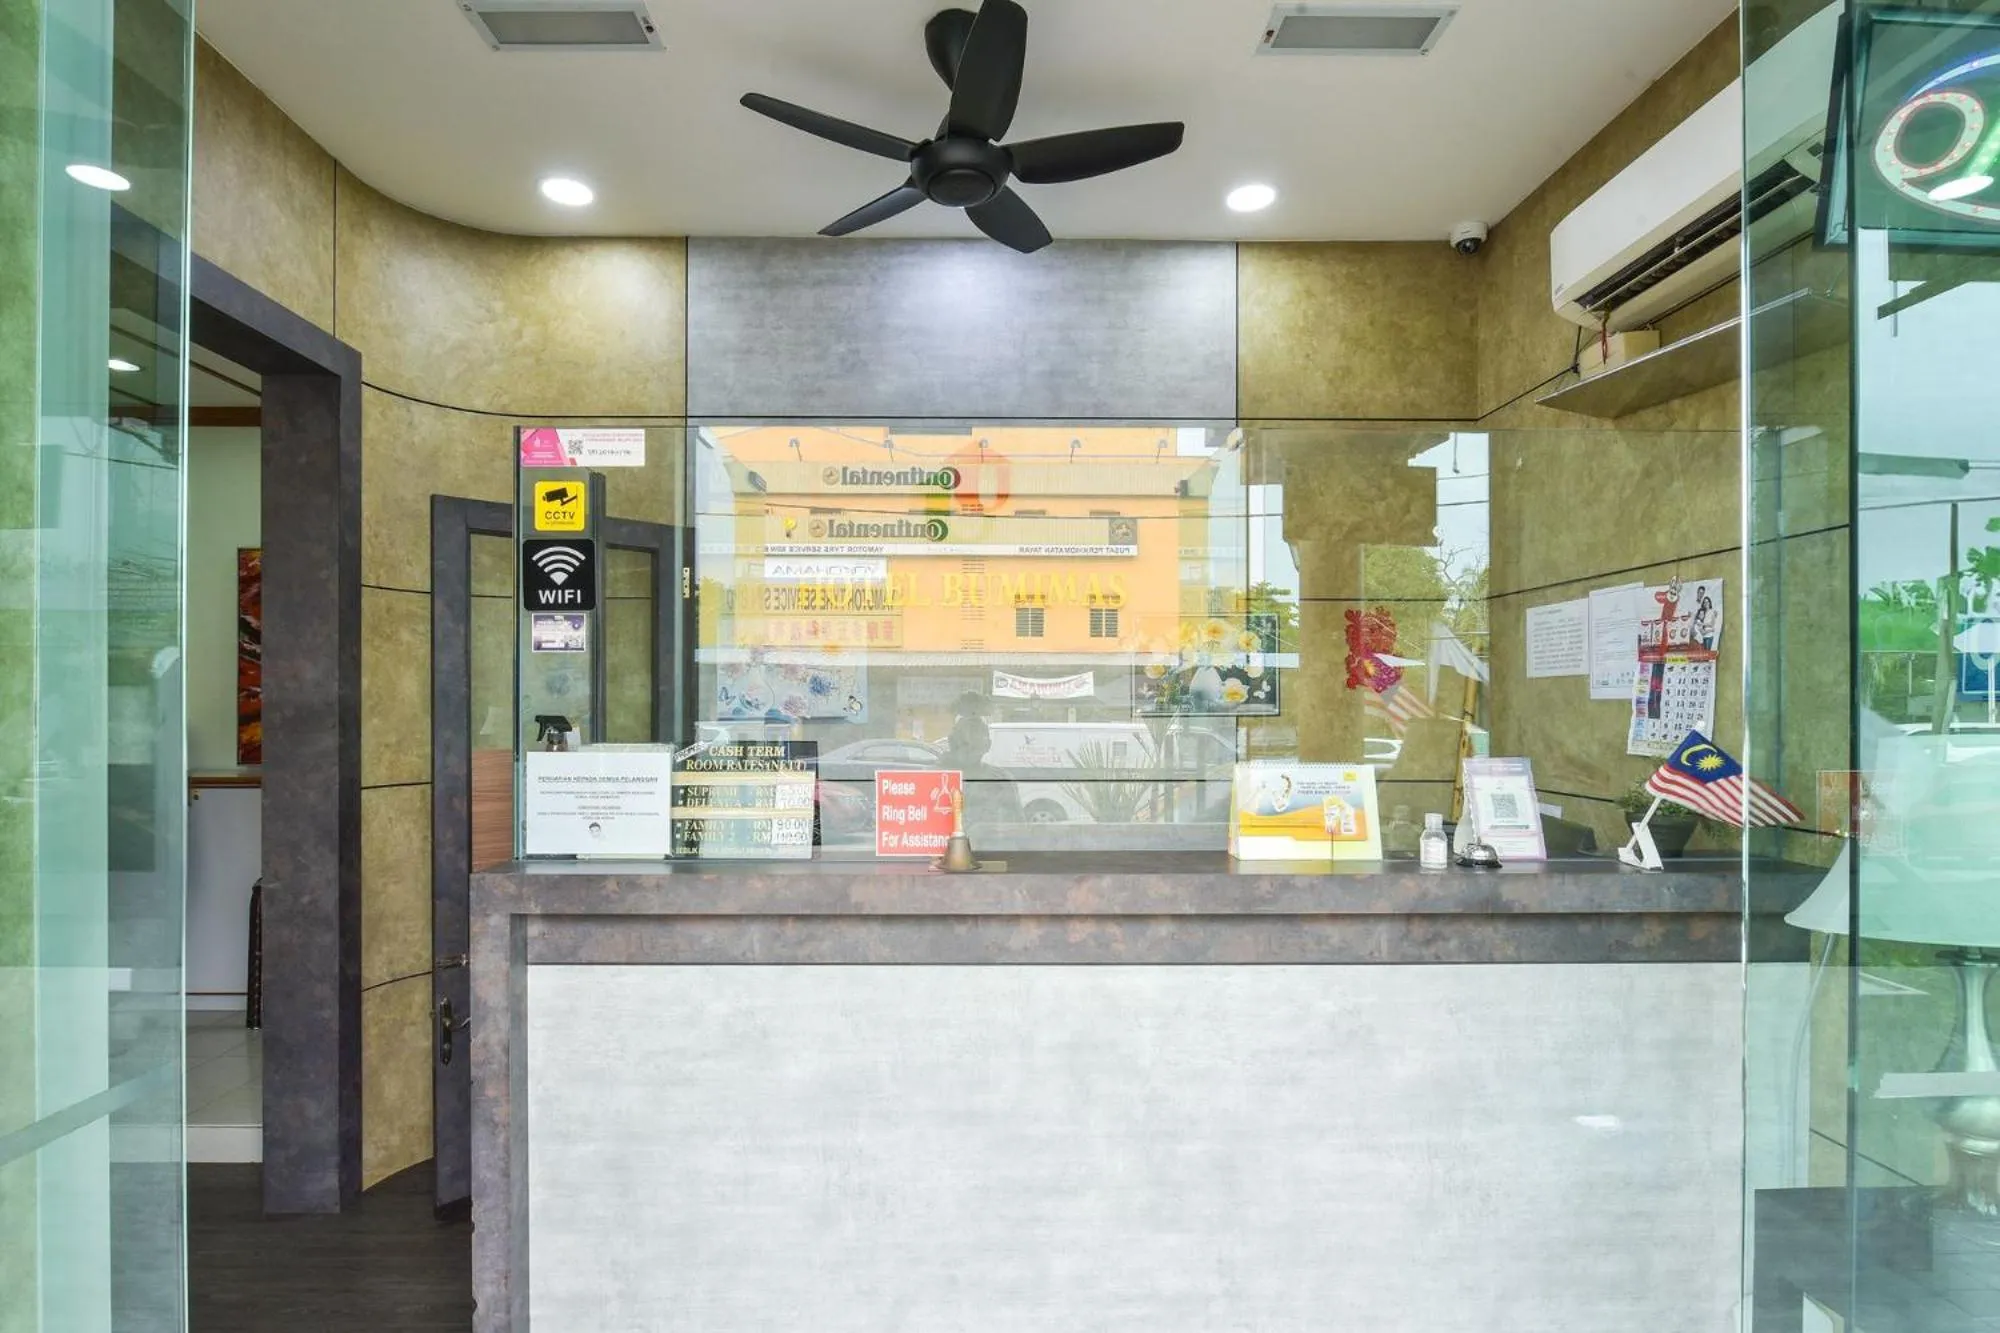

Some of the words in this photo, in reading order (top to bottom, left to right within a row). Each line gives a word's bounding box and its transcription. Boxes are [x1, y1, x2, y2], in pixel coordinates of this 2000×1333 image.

[545, 510, 575, 520] CCTV
[940, 570, 1128, 608] BUMIMAS
[538, 589, 582, 604] WIFI
[709, 746, 745, 757] CASH
[749, 746, 785, 757] TERM
[686, 759, 724, 771] ROOM
[882, 779, 916, 795] Please
[882, 804, 905, 825] Ring
[907, 804, 928, 821] Bell
[685, 820, 724, 830] FAMILY
[684, 831, 724, 842] FAMILY
[752, 831, 771, 843] RM
[882, 831, 901, 848] For
